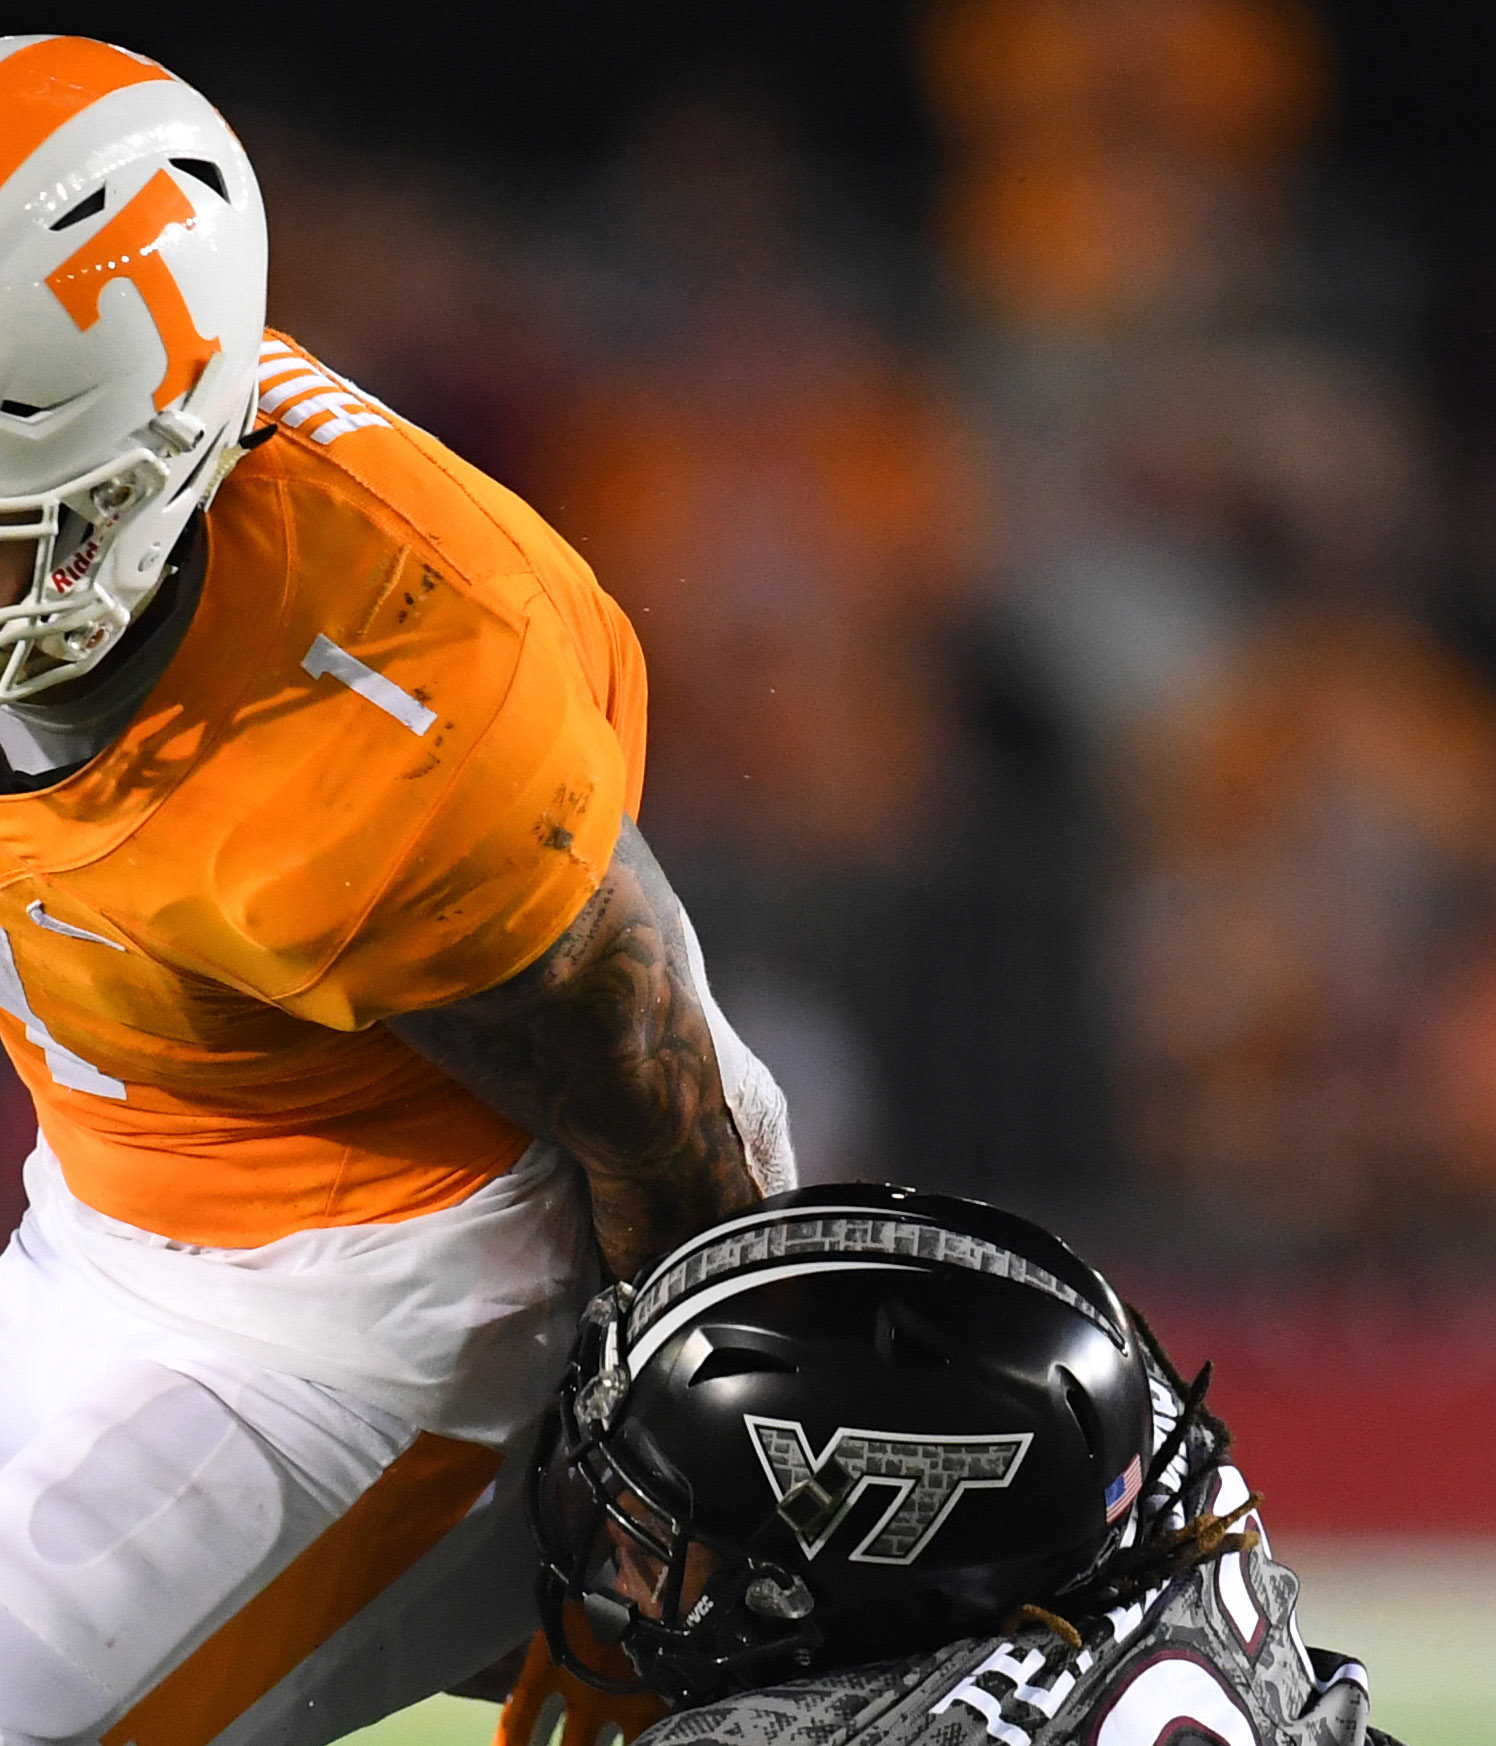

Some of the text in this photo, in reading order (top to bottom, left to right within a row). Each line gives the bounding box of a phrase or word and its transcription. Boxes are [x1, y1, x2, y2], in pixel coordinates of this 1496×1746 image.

[44, 168, 222, 414] T
[300, 632, 439, 738] 1
[743, 1413, 1035, 1566] VT
